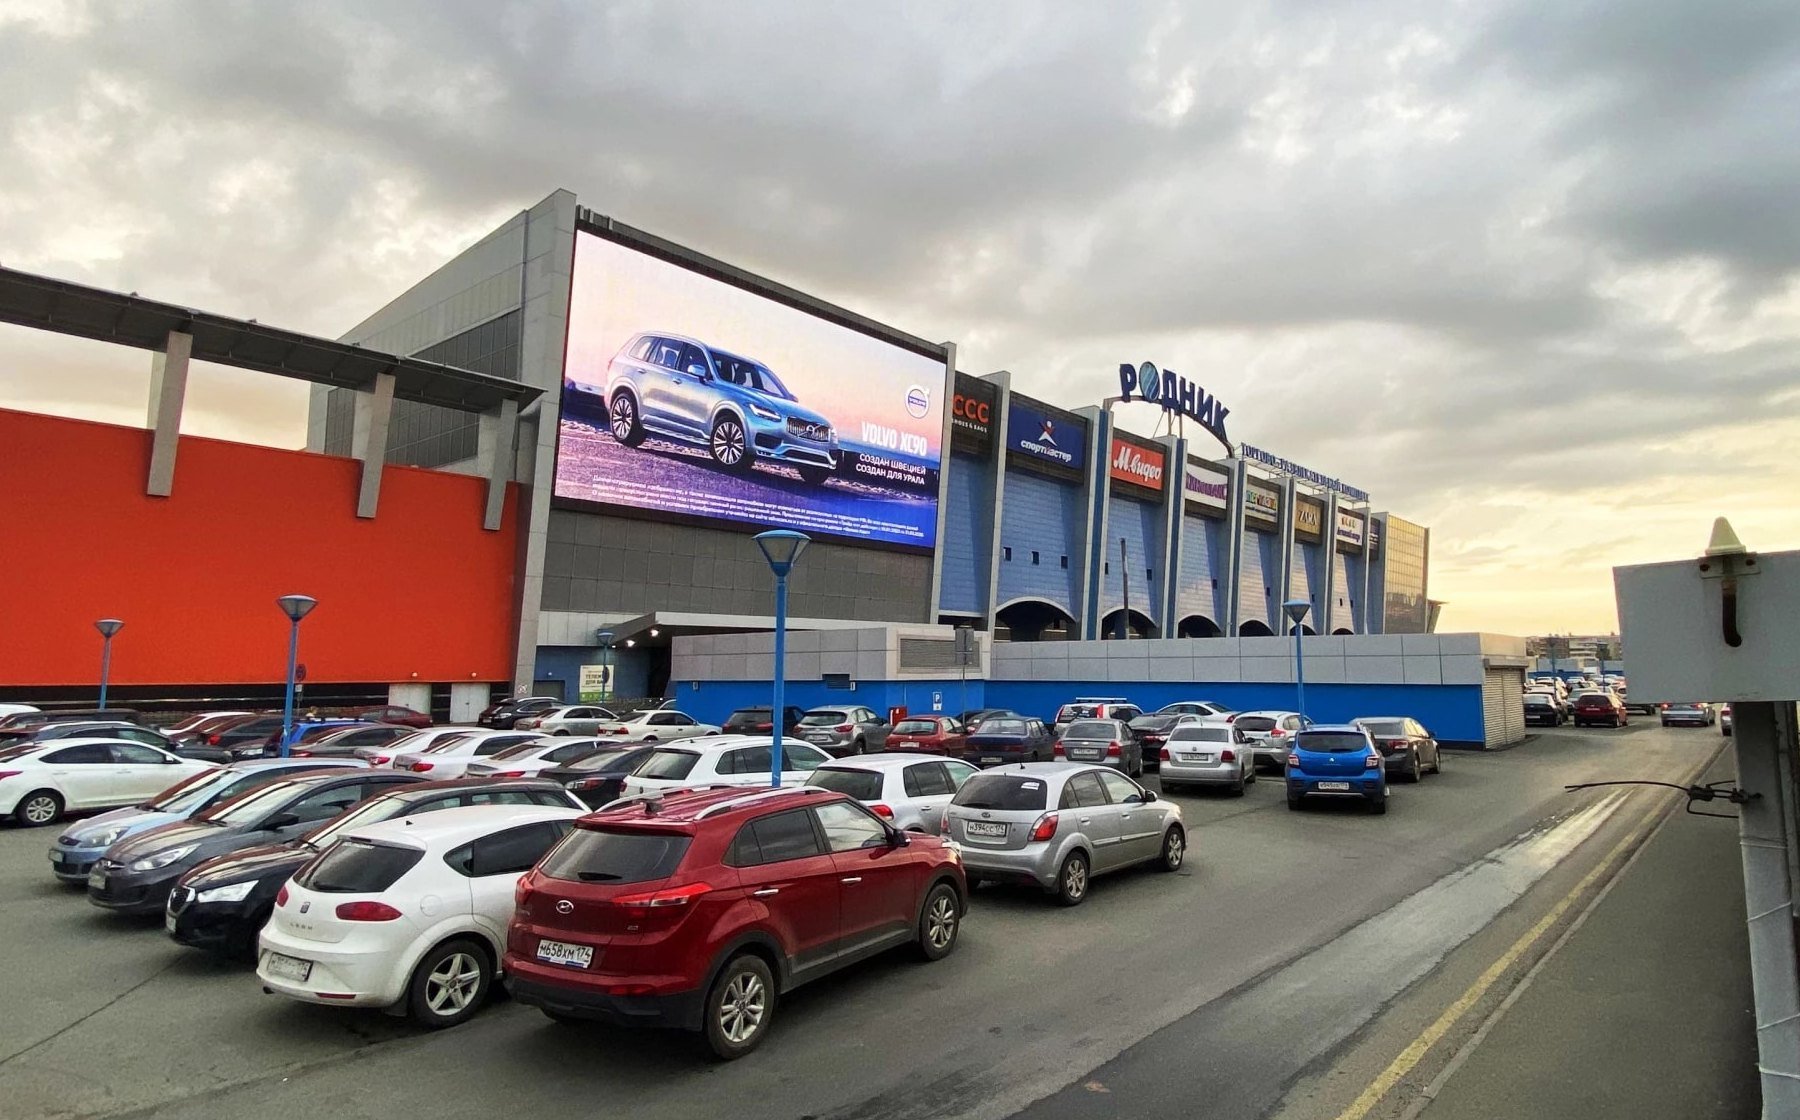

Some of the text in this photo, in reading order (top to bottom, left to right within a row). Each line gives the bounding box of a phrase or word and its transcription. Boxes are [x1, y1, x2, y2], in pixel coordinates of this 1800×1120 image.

[1119, 361, 1230, 440] РОДНИК
[862, 421, 927, 456] VOLVO XC90
[856, 463, 925, 485] СОЗДАН ДЛЯ УРАЛА
[860, 453, 926, 475] СОЗДАН ШВЕЦИЕЙ
[1113, 446, 1162, 481] М.видео
[1299, 511, 1317, 526] ZARA
